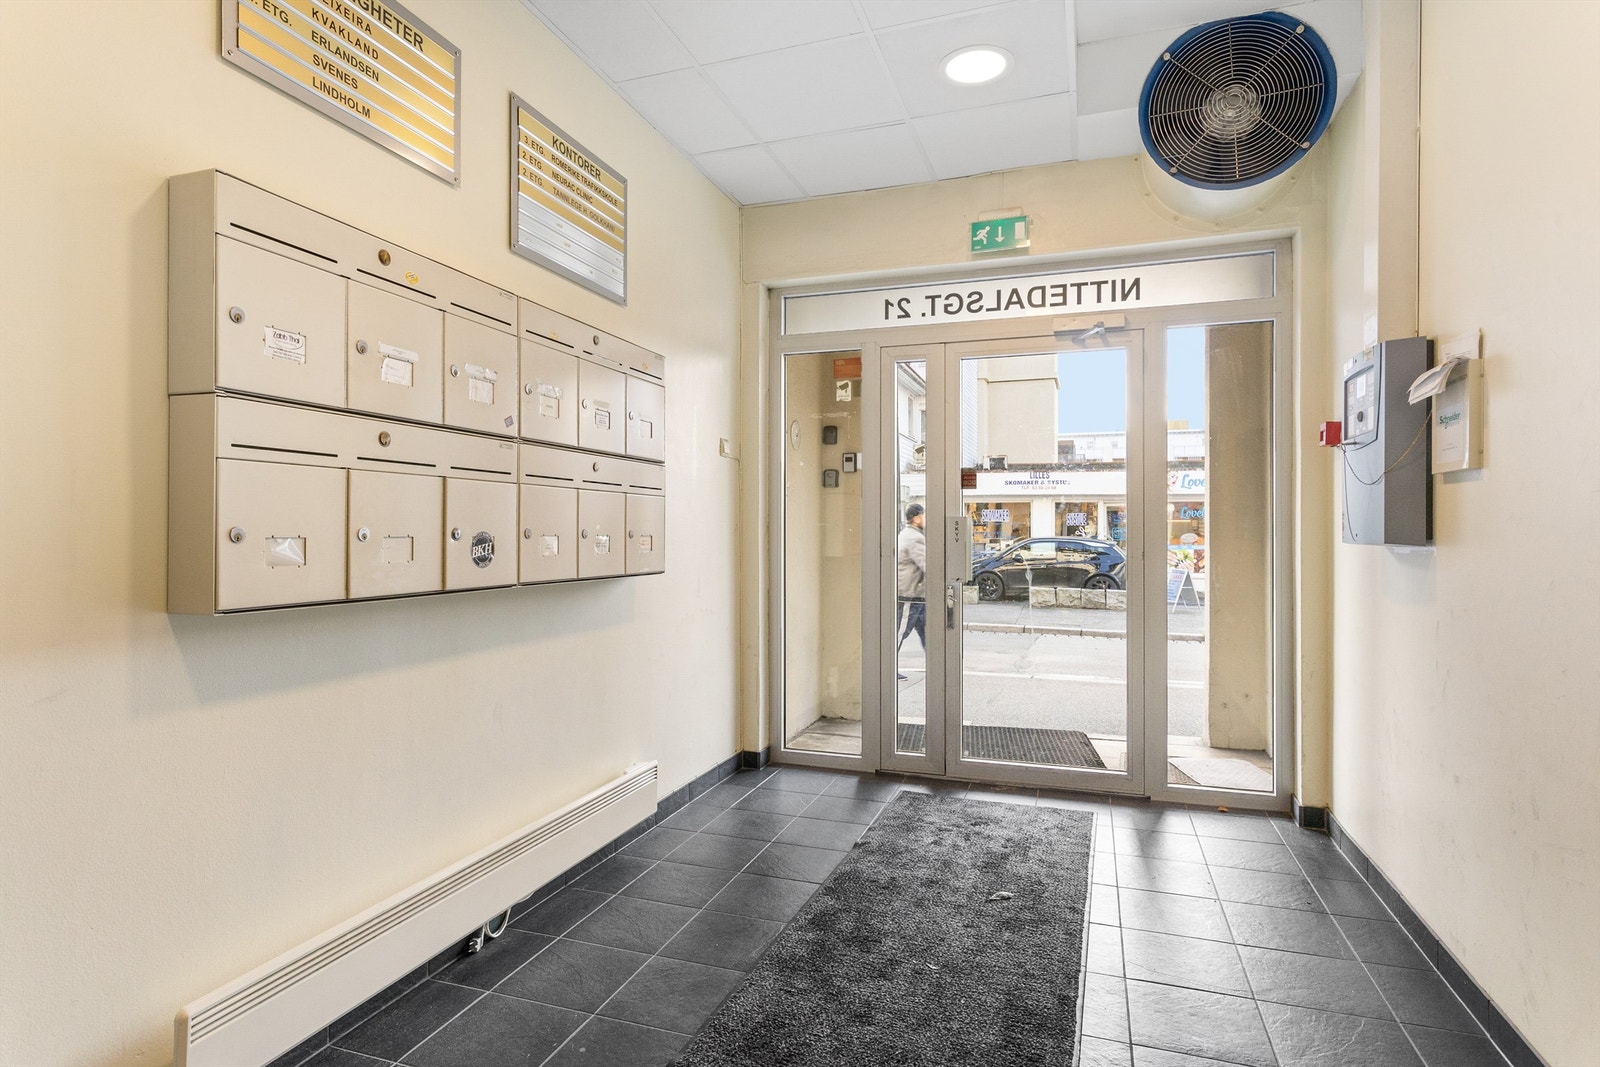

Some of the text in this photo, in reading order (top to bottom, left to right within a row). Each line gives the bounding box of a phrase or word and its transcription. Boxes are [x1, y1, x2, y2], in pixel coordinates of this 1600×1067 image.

[311, 7, 379, 60] KVAKLAND
[311, 30, 379, 82] ERLANDSEN
[312, 54, 358, 90] SVENES
[312, 76, 371, 119] LINDHOLM
[522, 150, 593, 204] 2. ETG. NEURAC CLINIC
[524, 135, 618, 208] 3. ETG. ROMERIKE TRAFIKKSKOLE
[552, 135, 601, 182] KONTORER
[530, 171, 545, 188] ETG.
[552, 186, 583, 212] TANNLEGE
